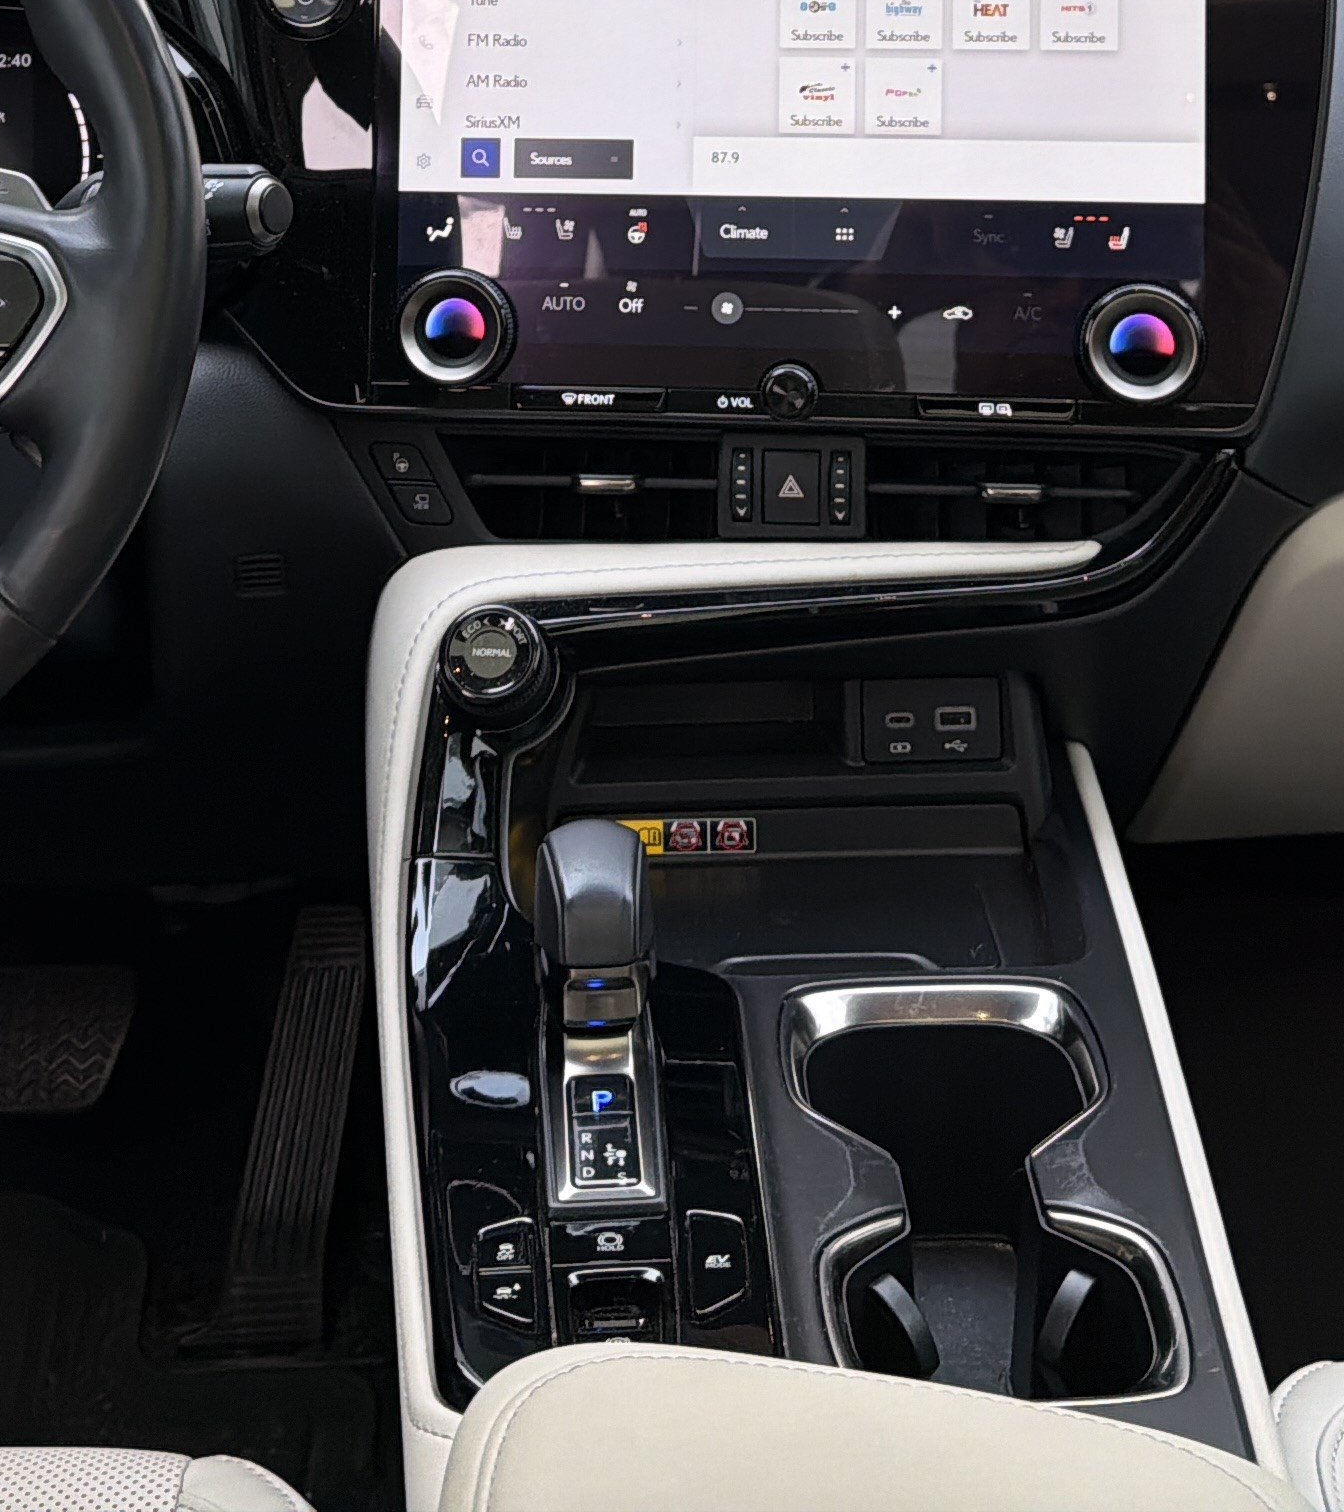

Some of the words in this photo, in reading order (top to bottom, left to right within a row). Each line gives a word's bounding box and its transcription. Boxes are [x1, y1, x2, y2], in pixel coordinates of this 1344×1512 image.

[973, 3, 1010, 17] HEAT
[467, 34, 489, 47] FM
[492, 34, 527, 48] Radio
[791, 29, 844, 42] Subscribe
[877, 30, 931, 42] Subscribe
[964, 31, 1018, 43] Subscribe
[1052, 31, 1106, 44] Subscribe
[466, 75, 489, 88] AM
[493, 75, 528, 88] Radio
[803, 93, 835, 102] vinyl
[465, 115, 521, 129] SiriusXM
[790, 115, 843, 127] Subscribe
[876, 115, 930, 128] Subscribe
[530, 151, 573, 166] Sources
[711, 152, 740, 164] 87.9
[628, 208, 648, 217] AUTO
[719, 223, 769, 241] Climate
[972, 228, 1005, 245] Sync
[542, 296, 586, 312] AUTO
[618, 297, 645, 314] Off
[1013, 305, 1043, 322] A/C
[577, 393, 615, 405] FRONT
[730, 396, 754, 408] VOL
[461, 619, 482, 639] ECO
[471, 647, 512, 658] NORMAL
[592, 1090, 613, 1113] P
[581, 1132, 593, 1144] R
[580, 1149, 595, 1162] N
[582, 1167, 596, 1179] D
[596, 1245, 624, 1253] HOLD
[706, 1254, 731, 1263] EV
